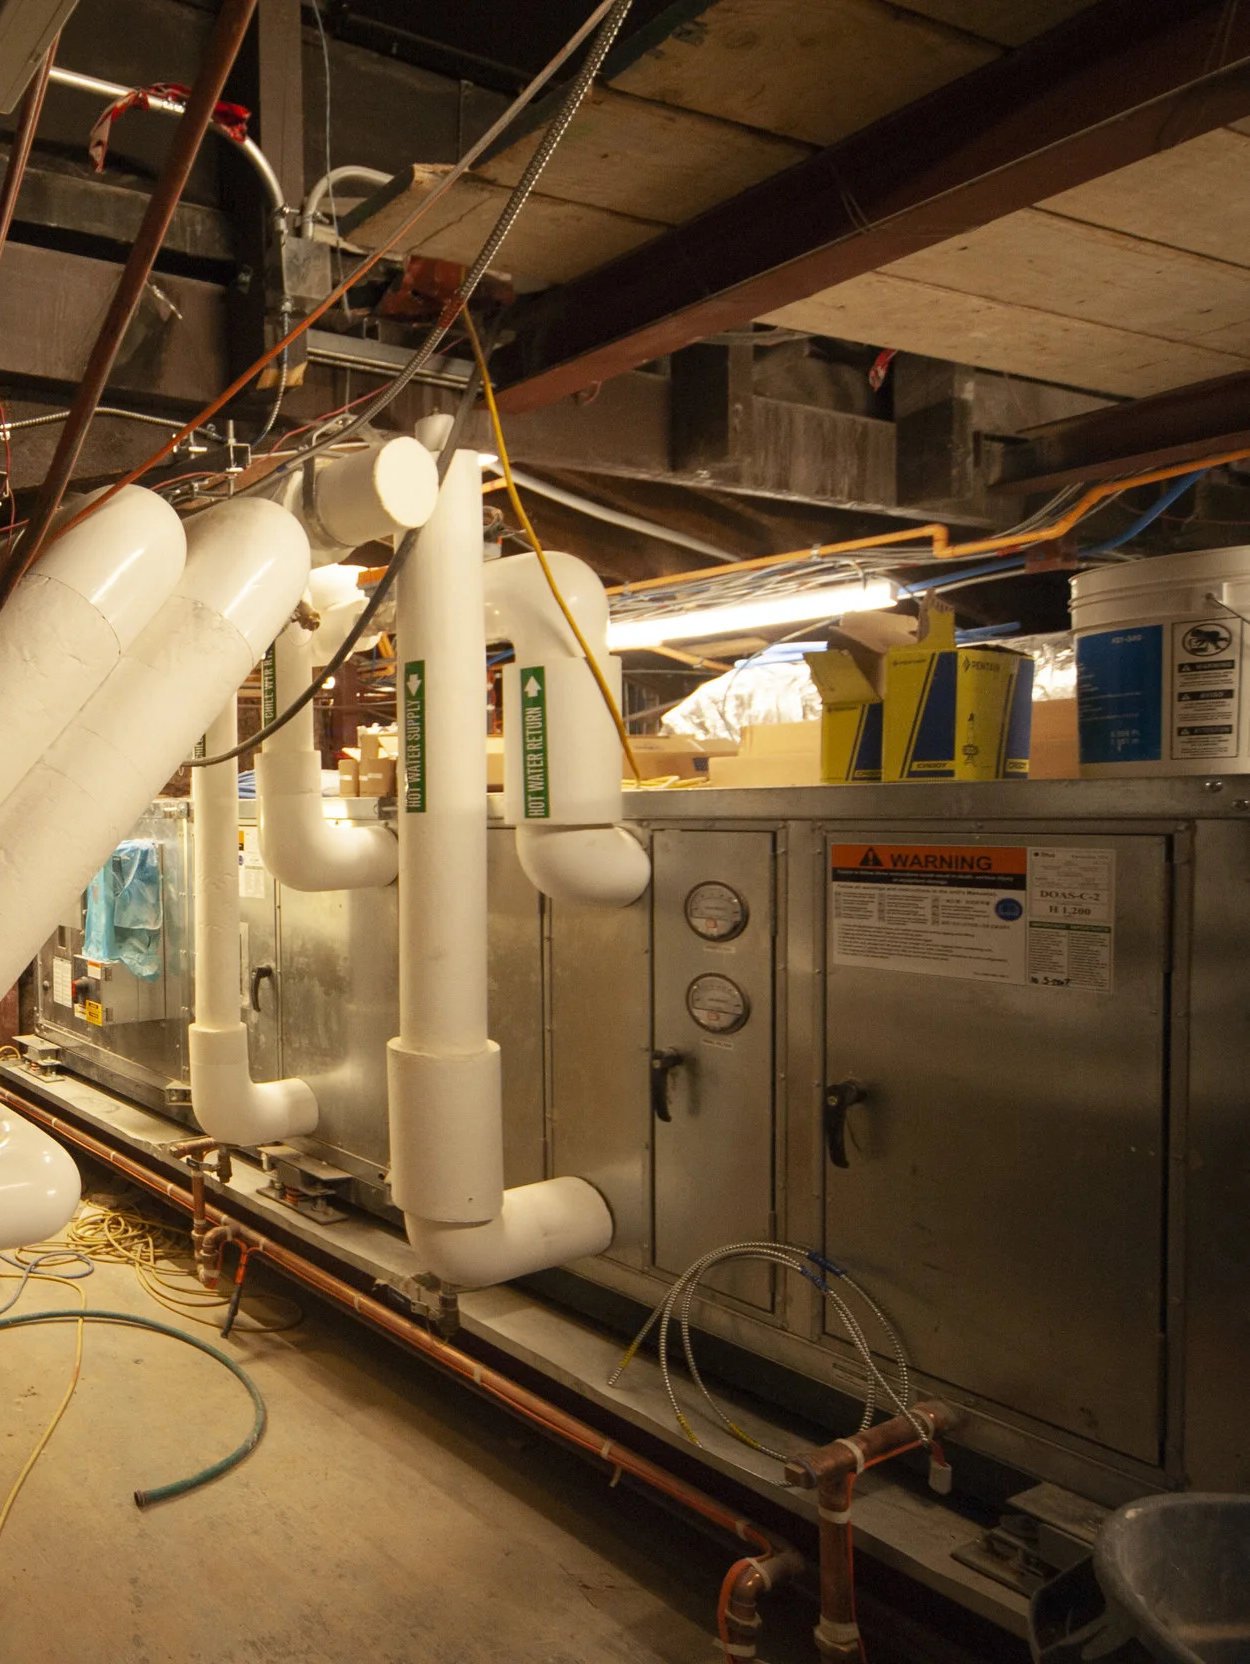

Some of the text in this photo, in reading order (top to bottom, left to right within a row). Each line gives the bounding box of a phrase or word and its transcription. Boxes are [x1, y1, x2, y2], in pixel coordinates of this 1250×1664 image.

[405, 699, 421, 808] HOT WATER SUPPLY
[525, 706, 545, 816] HOT WATER RETURN
[890, 853, 993, 870] WARNING
[1039, 890, 1100, 902] DOAS-C-2
[1049, 905, 1092, 916] H 1,200
